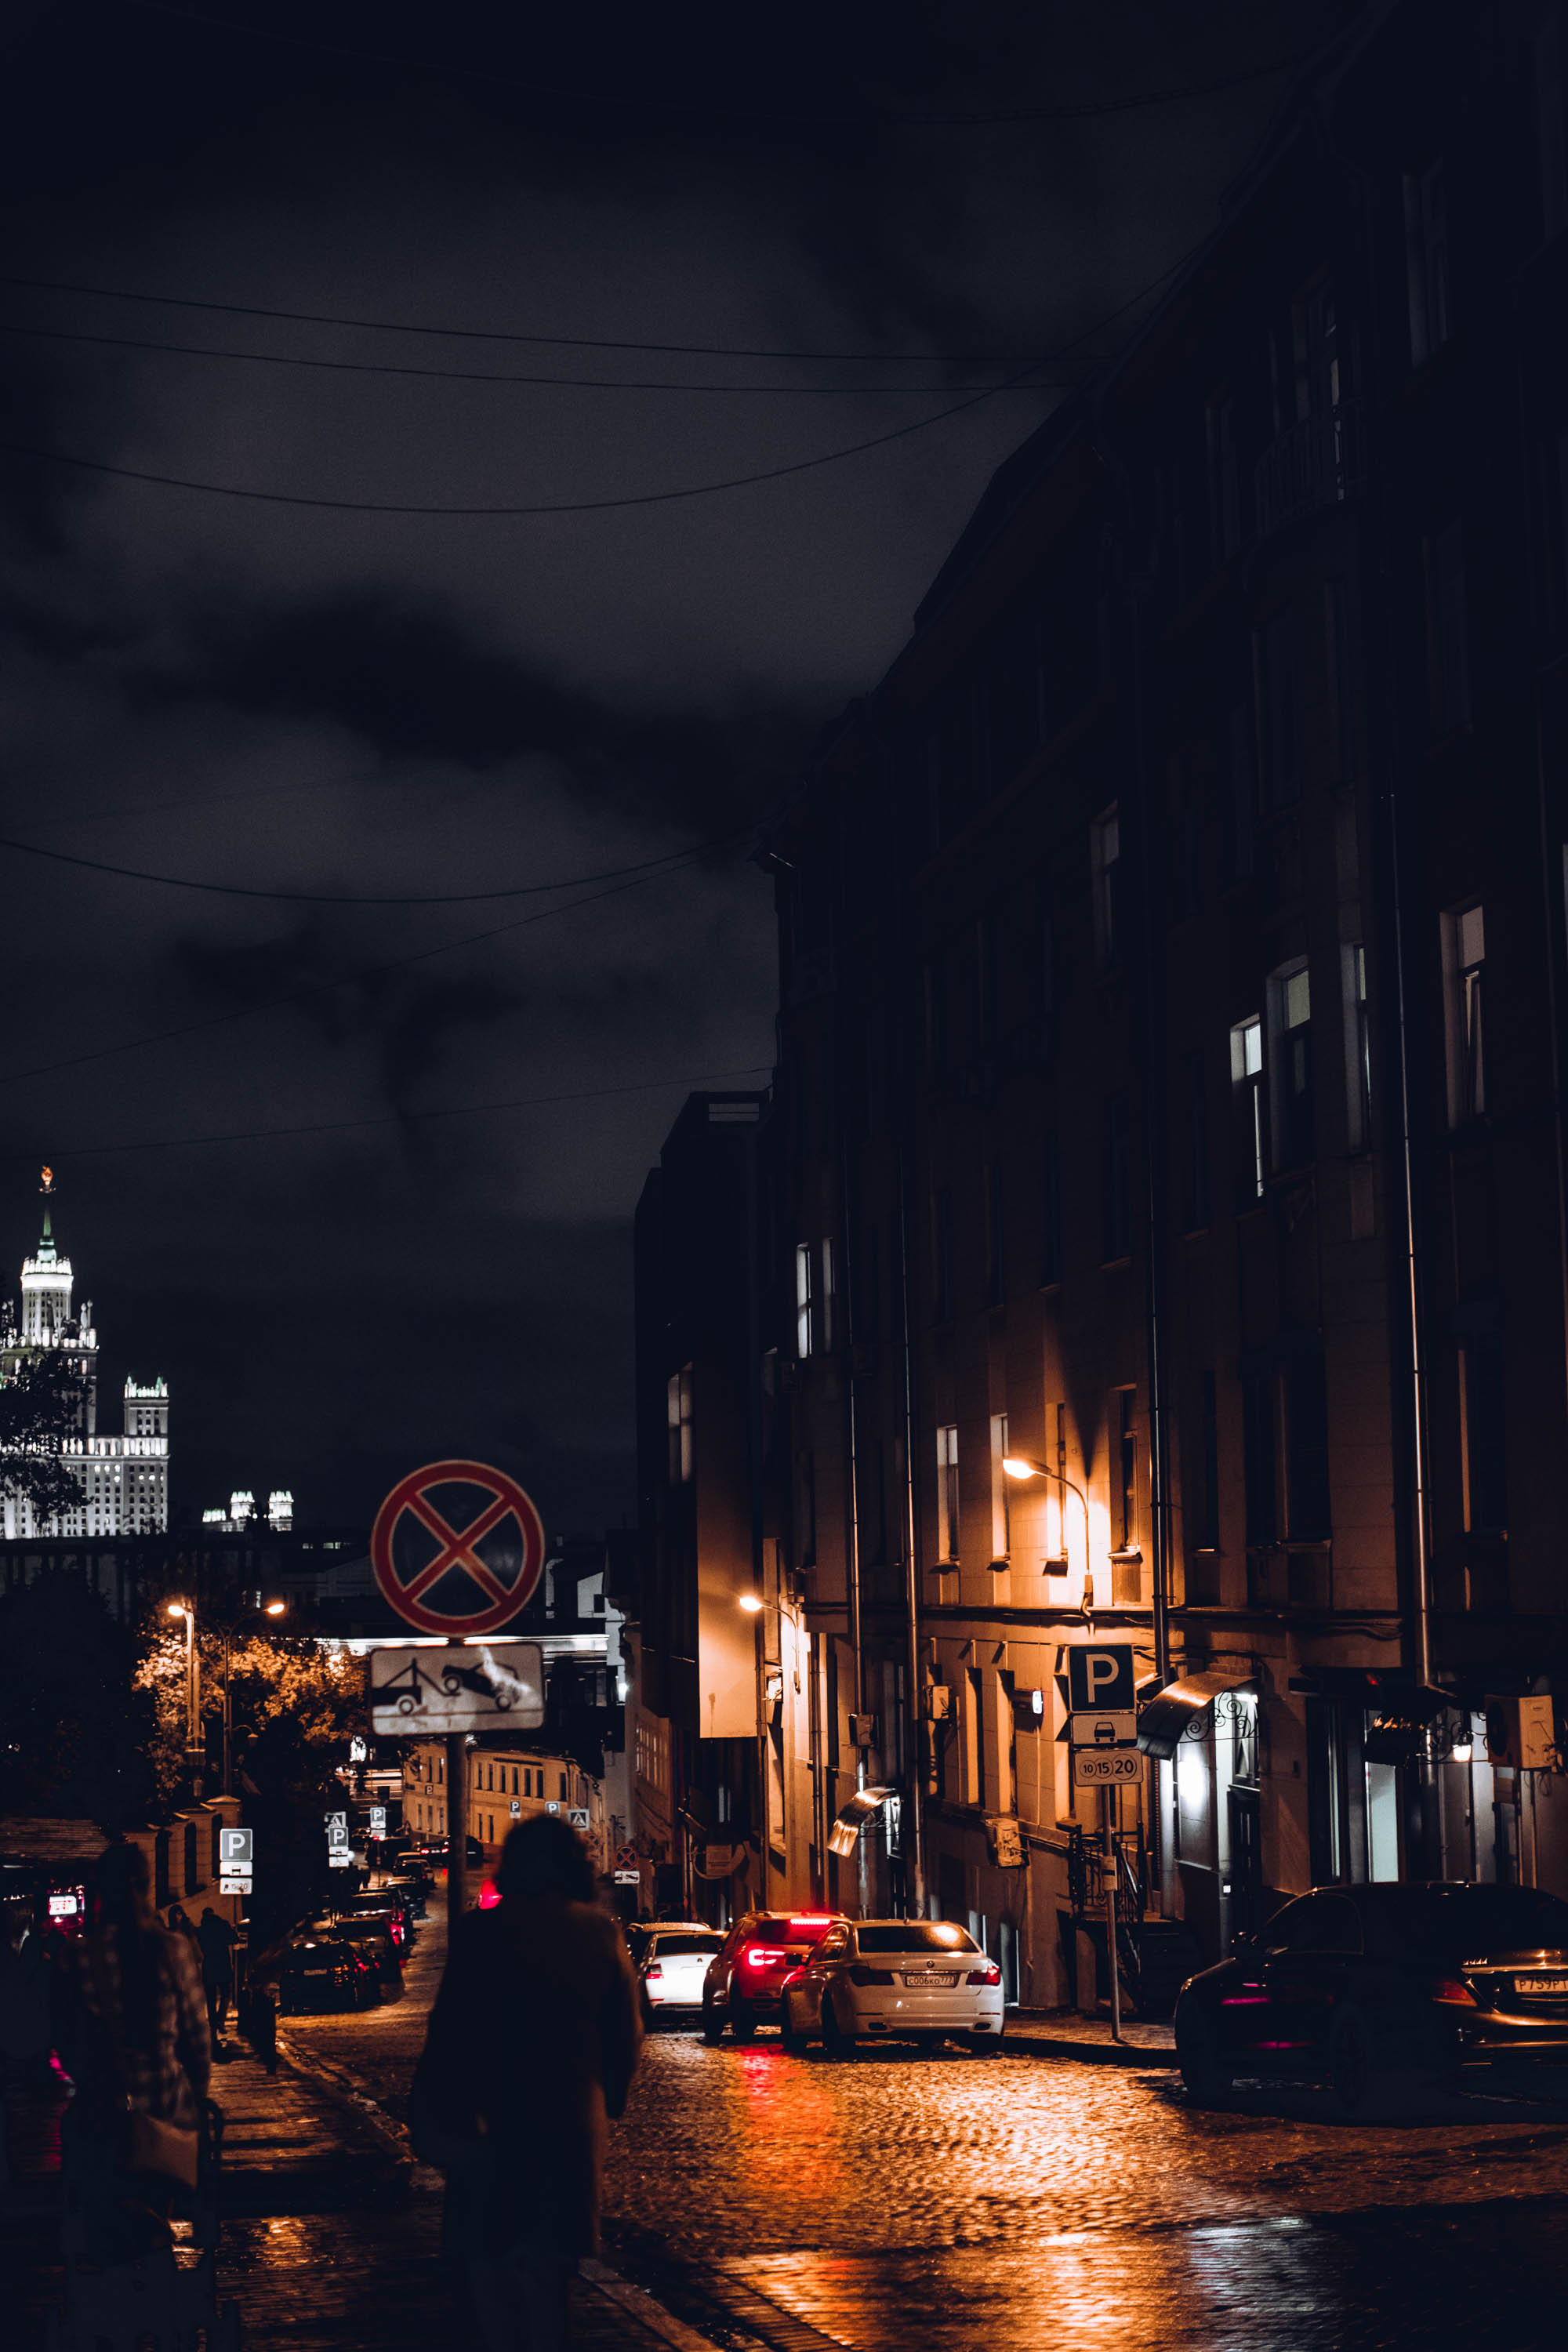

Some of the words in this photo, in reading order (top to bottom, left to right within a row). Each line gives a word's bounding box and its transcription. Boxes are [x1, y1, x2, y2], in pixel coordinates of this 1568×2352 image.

[1086, 1653, 1120, 1703] P
[1083, 1765, 1093, 1773] 10
[1098, 1762, 1109, 1773] 15
[1115, 1760, 1134, 1773] 20
[512, 1802, 519, 1811] P
[549, 1803, 557, 1813] P
[373, 1809, 382, 1820] P
[333, 1829, 345, 1844] P
[228, 1833, 245, 1857] P
